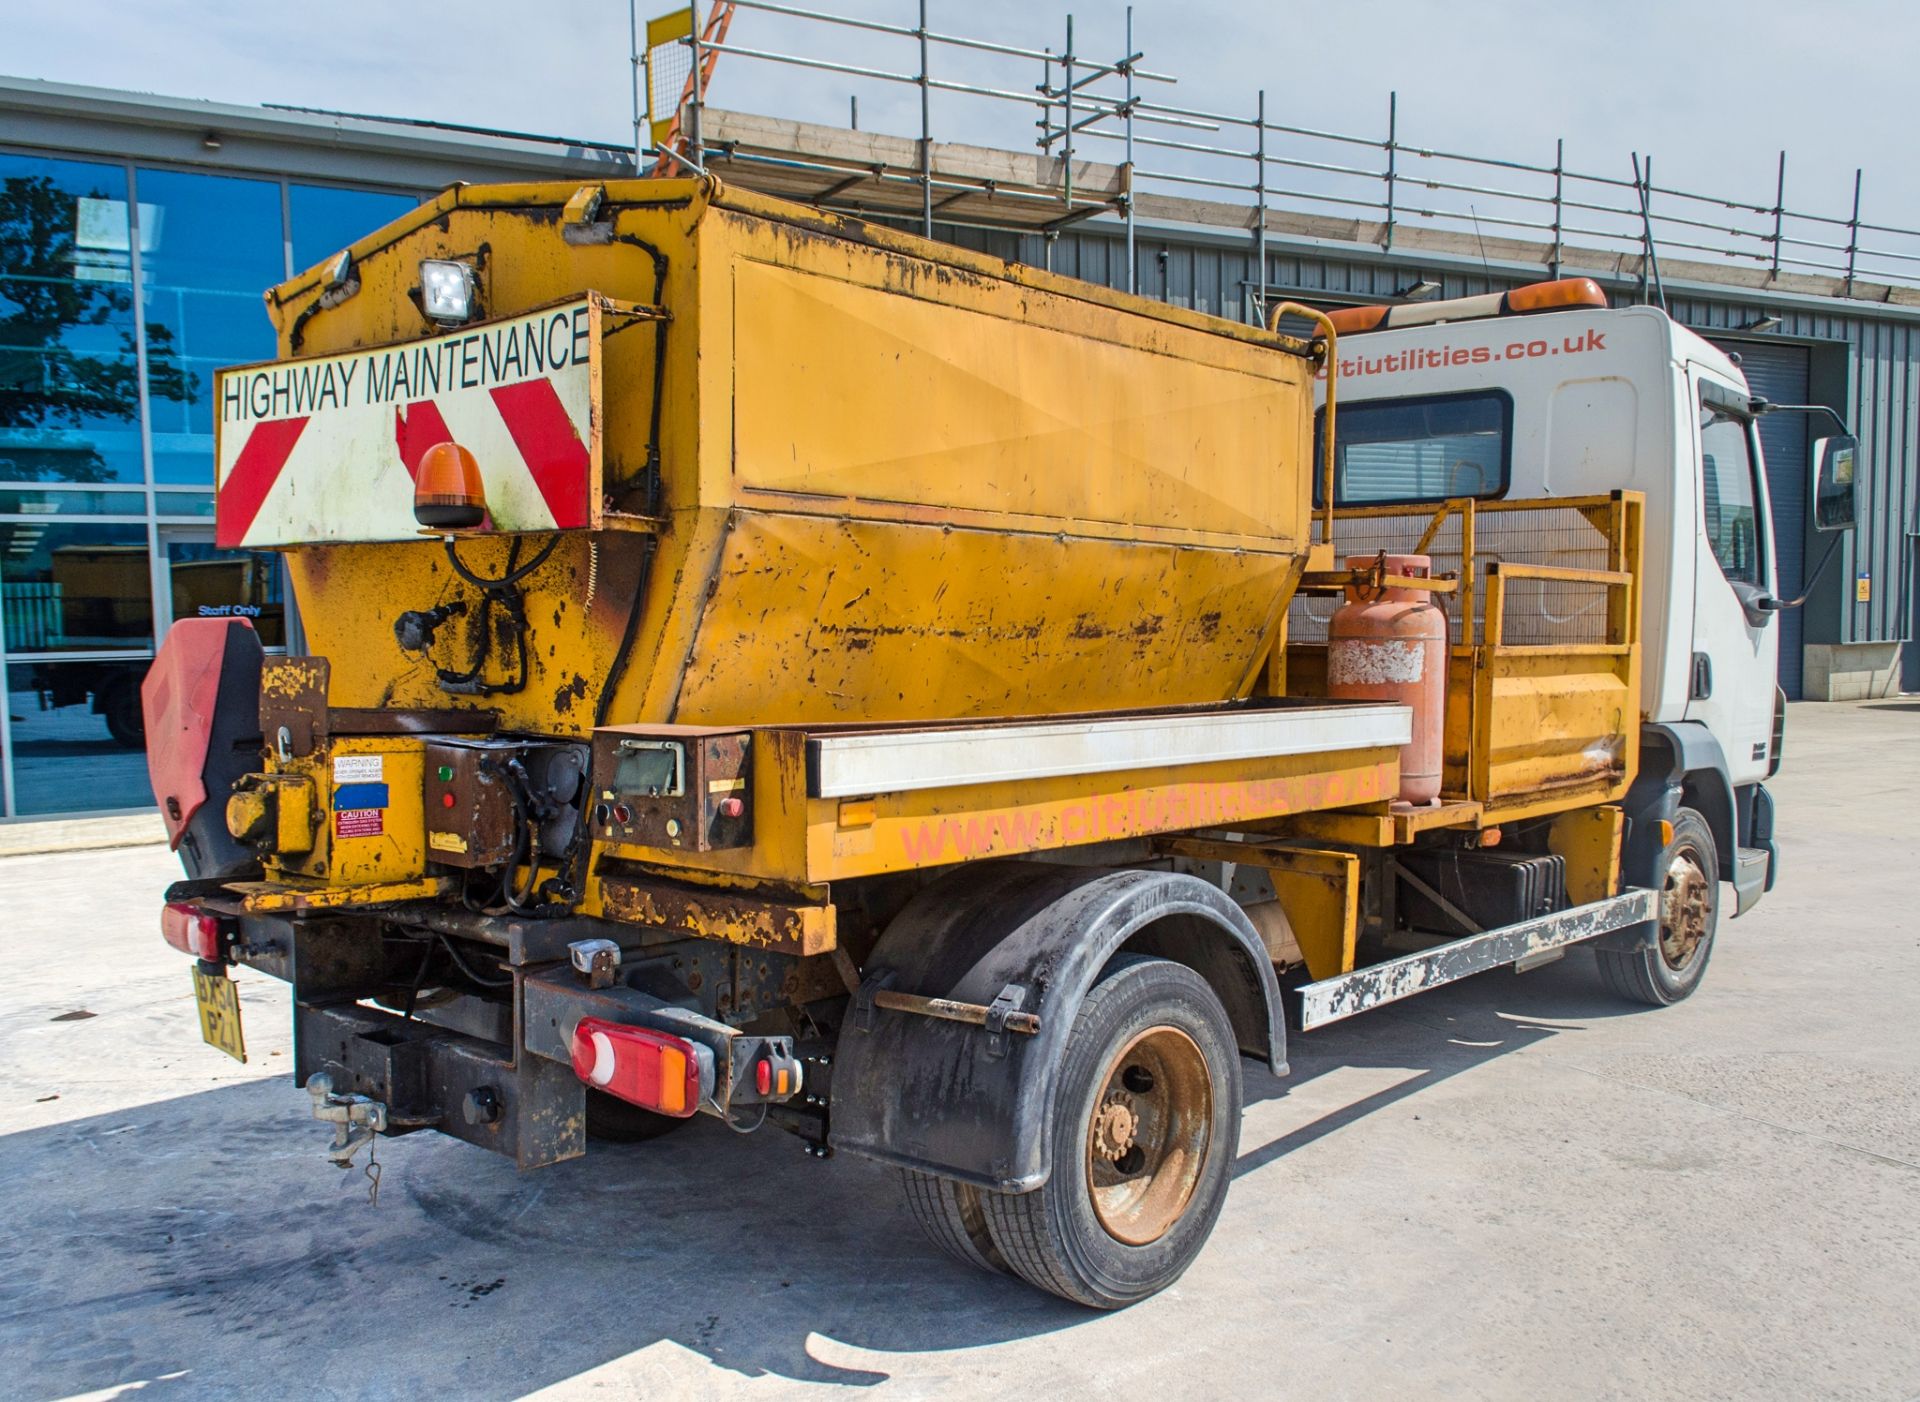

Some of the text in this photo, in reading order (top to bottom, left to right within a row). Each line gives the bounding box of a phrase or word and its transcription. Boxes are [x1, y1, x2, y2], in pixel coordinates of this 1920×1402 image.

[224, 307, 590, 422] HIGHWAY MAINTENANCE
[198, 604, 262, 617] Staff Only
[337, 758, 380, 769] WARNING
[341, 809, 379, 819] CAUTION
